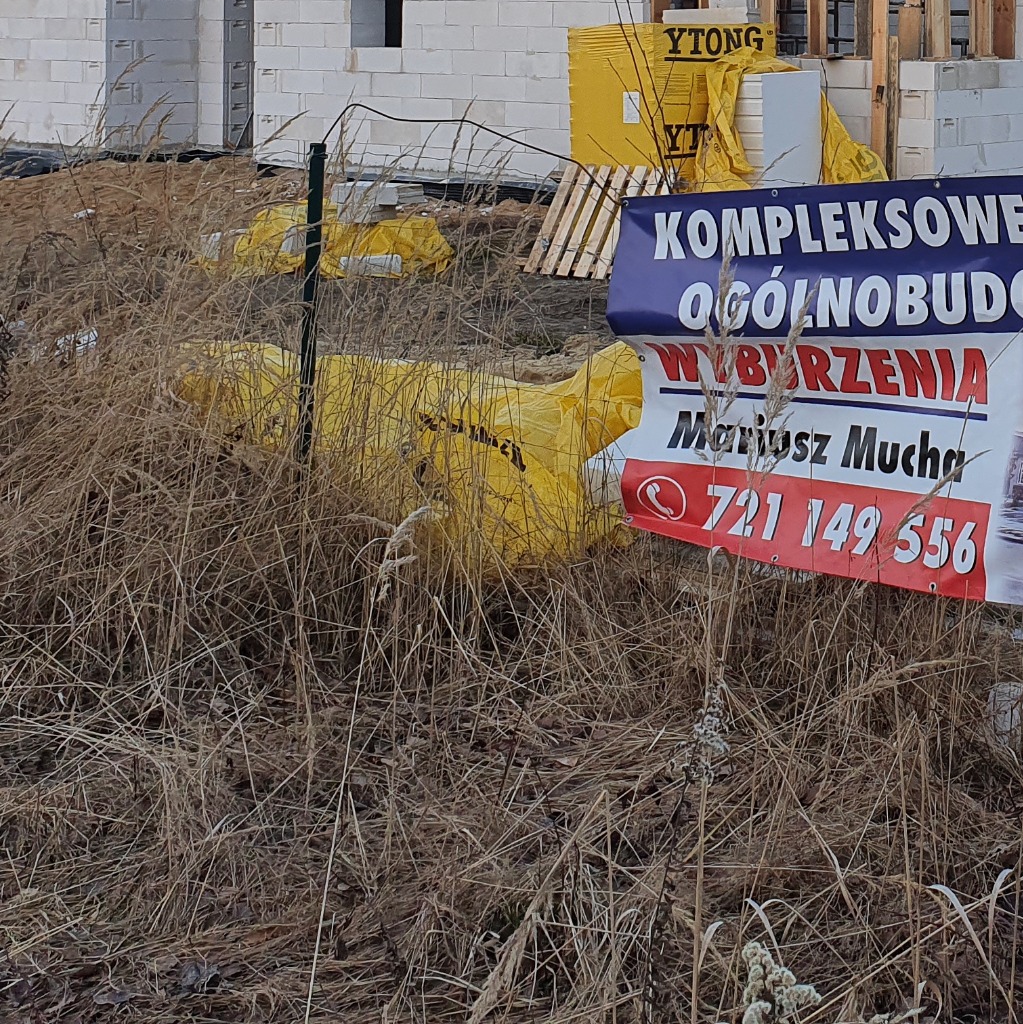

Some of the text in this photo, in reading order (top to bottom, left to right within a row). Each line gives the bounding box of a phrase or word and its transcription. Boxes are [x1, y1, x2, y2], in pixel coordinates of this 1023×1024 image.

[663, 27, 765, 56] YTONG
[841, 424, 966, 483] Mucha
[702, 484, 977, 574] 721 149 556
